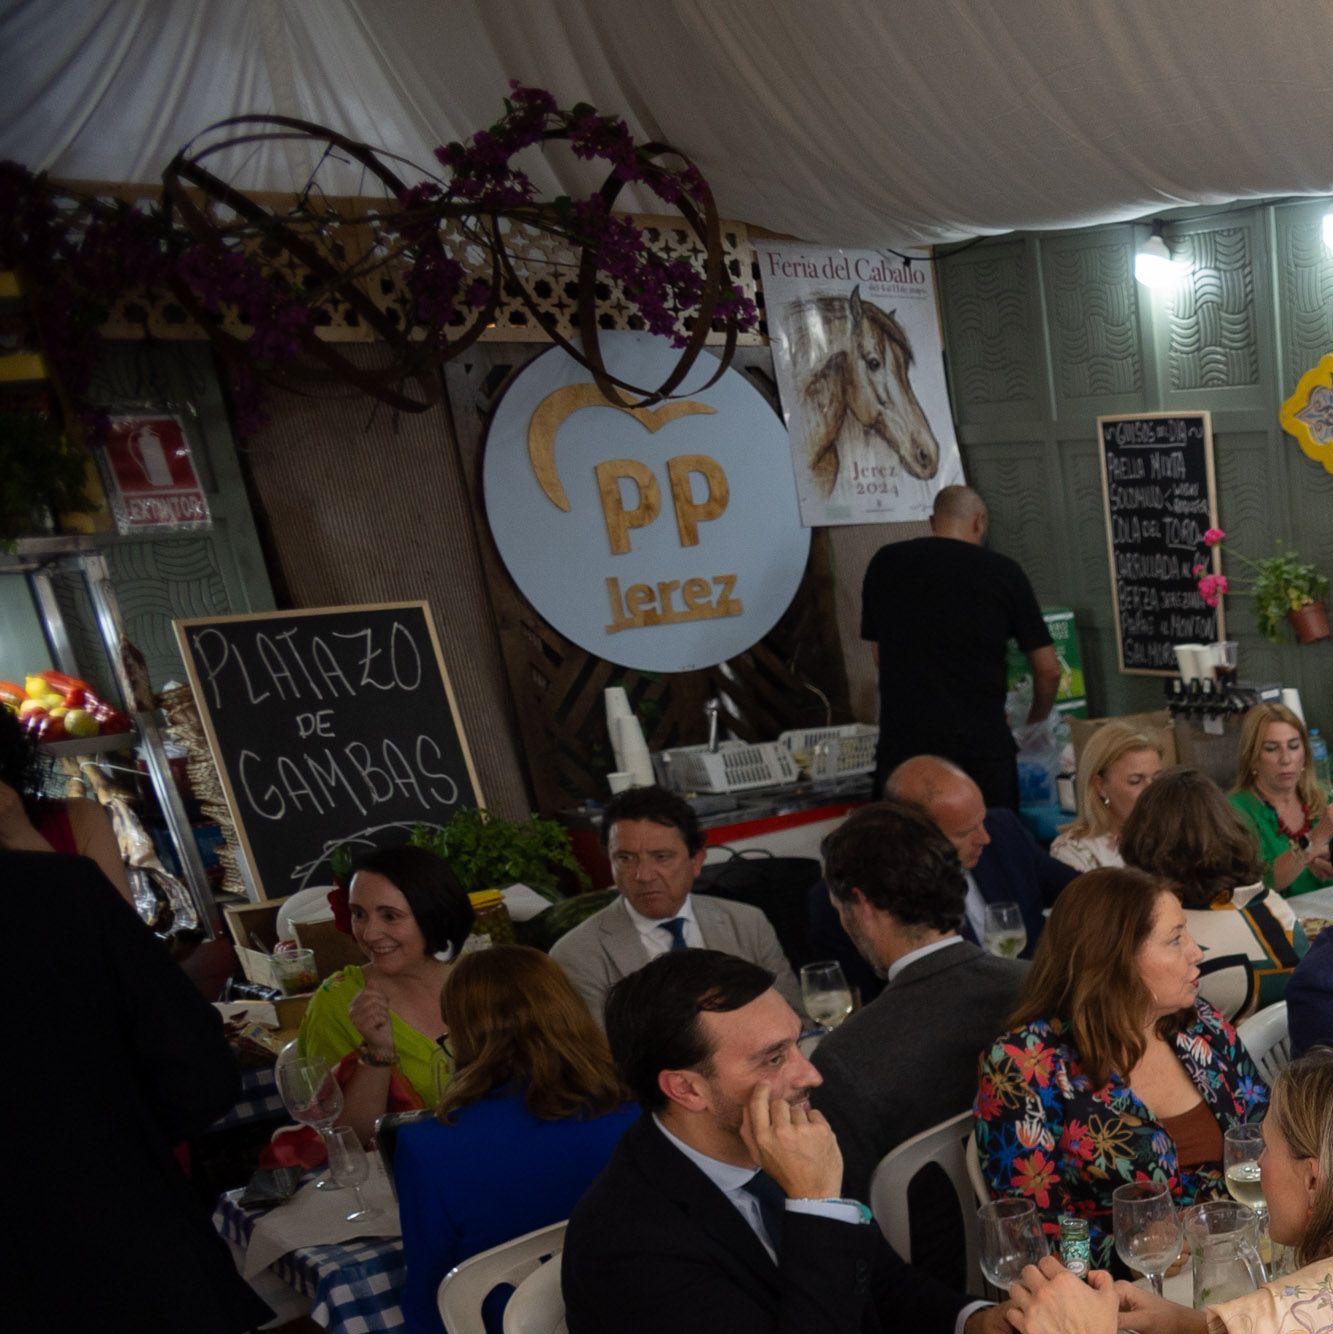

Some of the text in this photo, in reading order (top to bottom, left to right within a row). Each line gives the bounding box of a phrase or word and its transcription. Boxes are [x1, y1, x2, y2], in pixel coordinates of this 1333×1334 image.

[767, 252, 926, 284] Feria del Caballo
[853, 461, 898, 480] Jerez
[193, 621, 421, 709] PLATAZO
[296, 710, 336, 738] DE
[239, 735, 458, 820] GAMBAS
